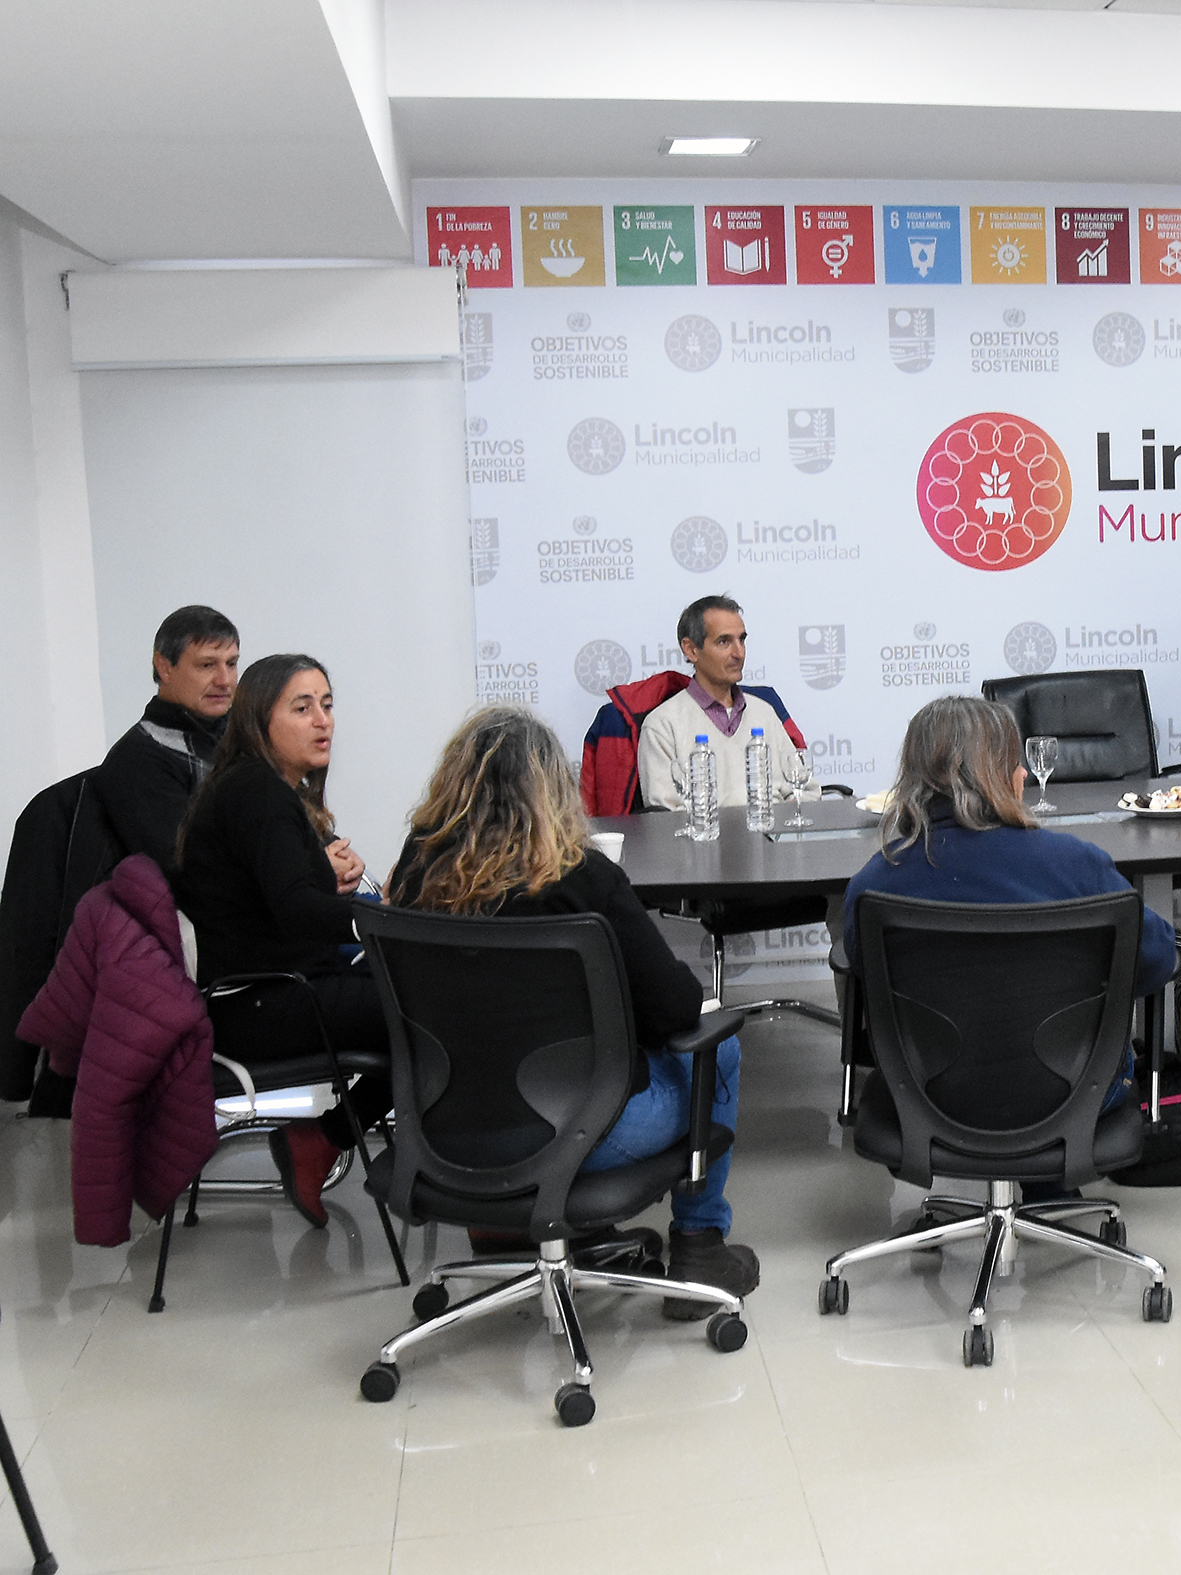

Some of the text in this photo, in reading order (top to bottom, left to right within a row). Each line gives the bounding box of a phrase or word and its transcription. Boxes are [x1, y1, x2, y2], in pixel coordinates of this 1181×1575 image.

[436, 213, 443, 231] 1
[446, 214, 456, 222] FIN
[529, 212, 537, 230] 2
[621, 211, 631, 229] 3
[635, 211, 655, 220] SALUD
[712, 211, 722, 229] 4
[727, 210, 761, 220] EDUCACIÓN
[802, 211, 812, 229] 5
[818, 211, 847, 220] IGUALDAD
[890, 211, 899, 229] 6
[977, 212, 985, 229] 7
[1061, 213, 1070, 230] 8
[1074, 213, 1123, 222] TRABAJO DECENTE
[1145, 214, 1154, 231] 9
[446, 222, 493, 231] DE LA POBREZA
[636, 221, 672, 230] Y BIENESTAR
[728, 221, 761, 229] DE CALIDAD
[818, 220, 849, 229] DE GÉNERO
[1074, 222, 1114, 230] Y CRECIMIENTO
[1074, 230, 1106, 239] ECONÓMICO
[731, 320, 832, 344] Lincoln
[969, 330, 1059, 346] OBJETIVOS
[531, 336, 628, 352] OBJETIVOS
[532, 353, 628, 365] DE DESARROLLO
[731, 346, 856, 366] Municipalidad
[971, 348, 1059, 358] DE DESARROLLO
[533, 365, 629, 380] SOSTENIBLE
[971, 358, 1060, 373] SOSTENIBLE
[634, 422, 738, 447] Lincoln
[471, 439, 524, 455] TIVOS
[471, 457, 525, 468] ARROLLO
[635, 448, 761, 466] Municipalidad
[472, 469, 526, 483] ENIBLE
[736, 519, 837, 545] Lincoln
[537, 538, 633, 556] OBJETIVOS
[737, 545, 860, 564] Municipalidad
[539, 556, 634, 568] DE DESARROLLO
[539, 567, 634, 583] SOSTENIBLE
[1064, 624, 1158, 650] Lincoln
[880, 643, 970, 661] OBJETIVOS
[1065, 648, 1180, 668] Municipalidad
[882, 660, 970, 673] DE DESARROLLO
[484, 680, 539, 692] ARROLLO
[882, 671, 970, 687] SOSTENIBLE
[813, 757, 875, 776] palidad
[765, 928, 833, 950] Linco
